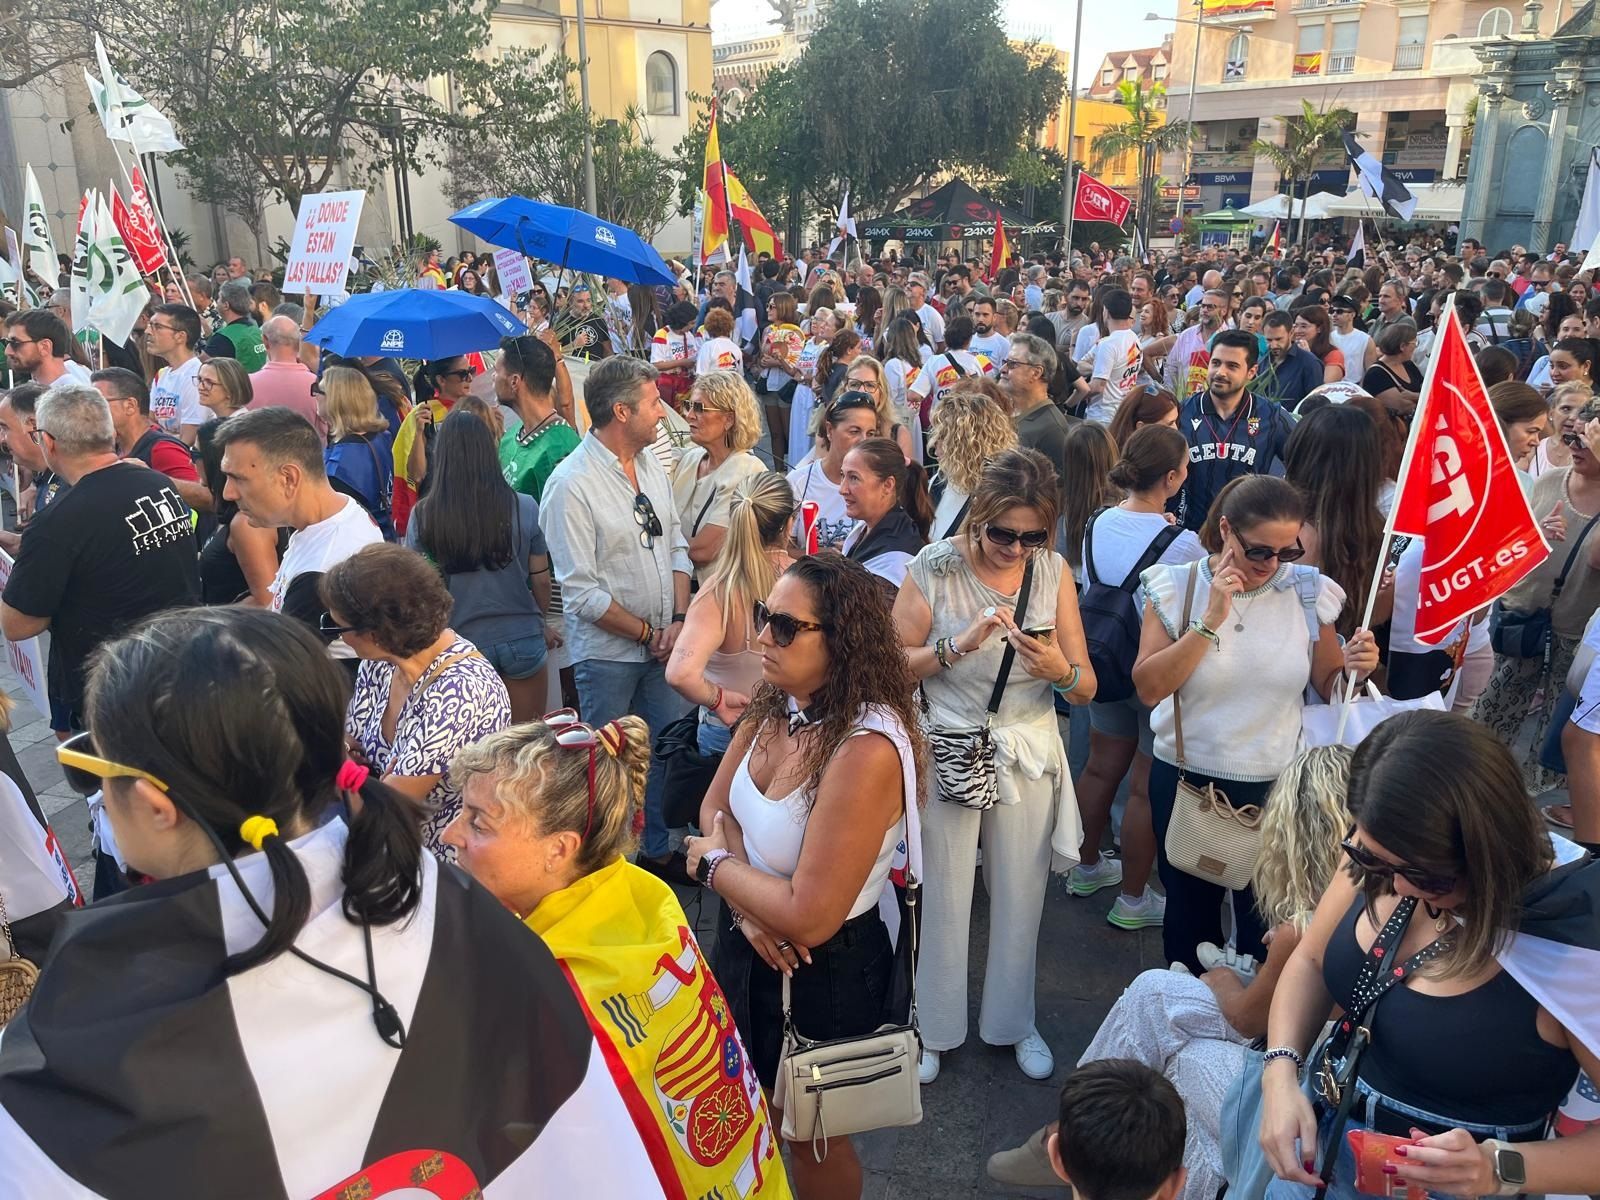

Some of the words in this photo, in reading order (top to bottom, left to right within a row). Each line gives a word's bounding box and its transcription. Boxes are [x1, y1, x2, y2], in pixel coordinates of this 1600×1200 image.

[1214, 174, 1236, 183] BBVA
[865, 227, 891, 236] 24MX
[905, 228, 934, 237] 24MX
[287, 262, 304, 282] LAS
[305, 261, 344, 284] VALLAS?
[380, 340, 404, 348] ANPE
[1188, 442, 1257, 466] CEUTA
